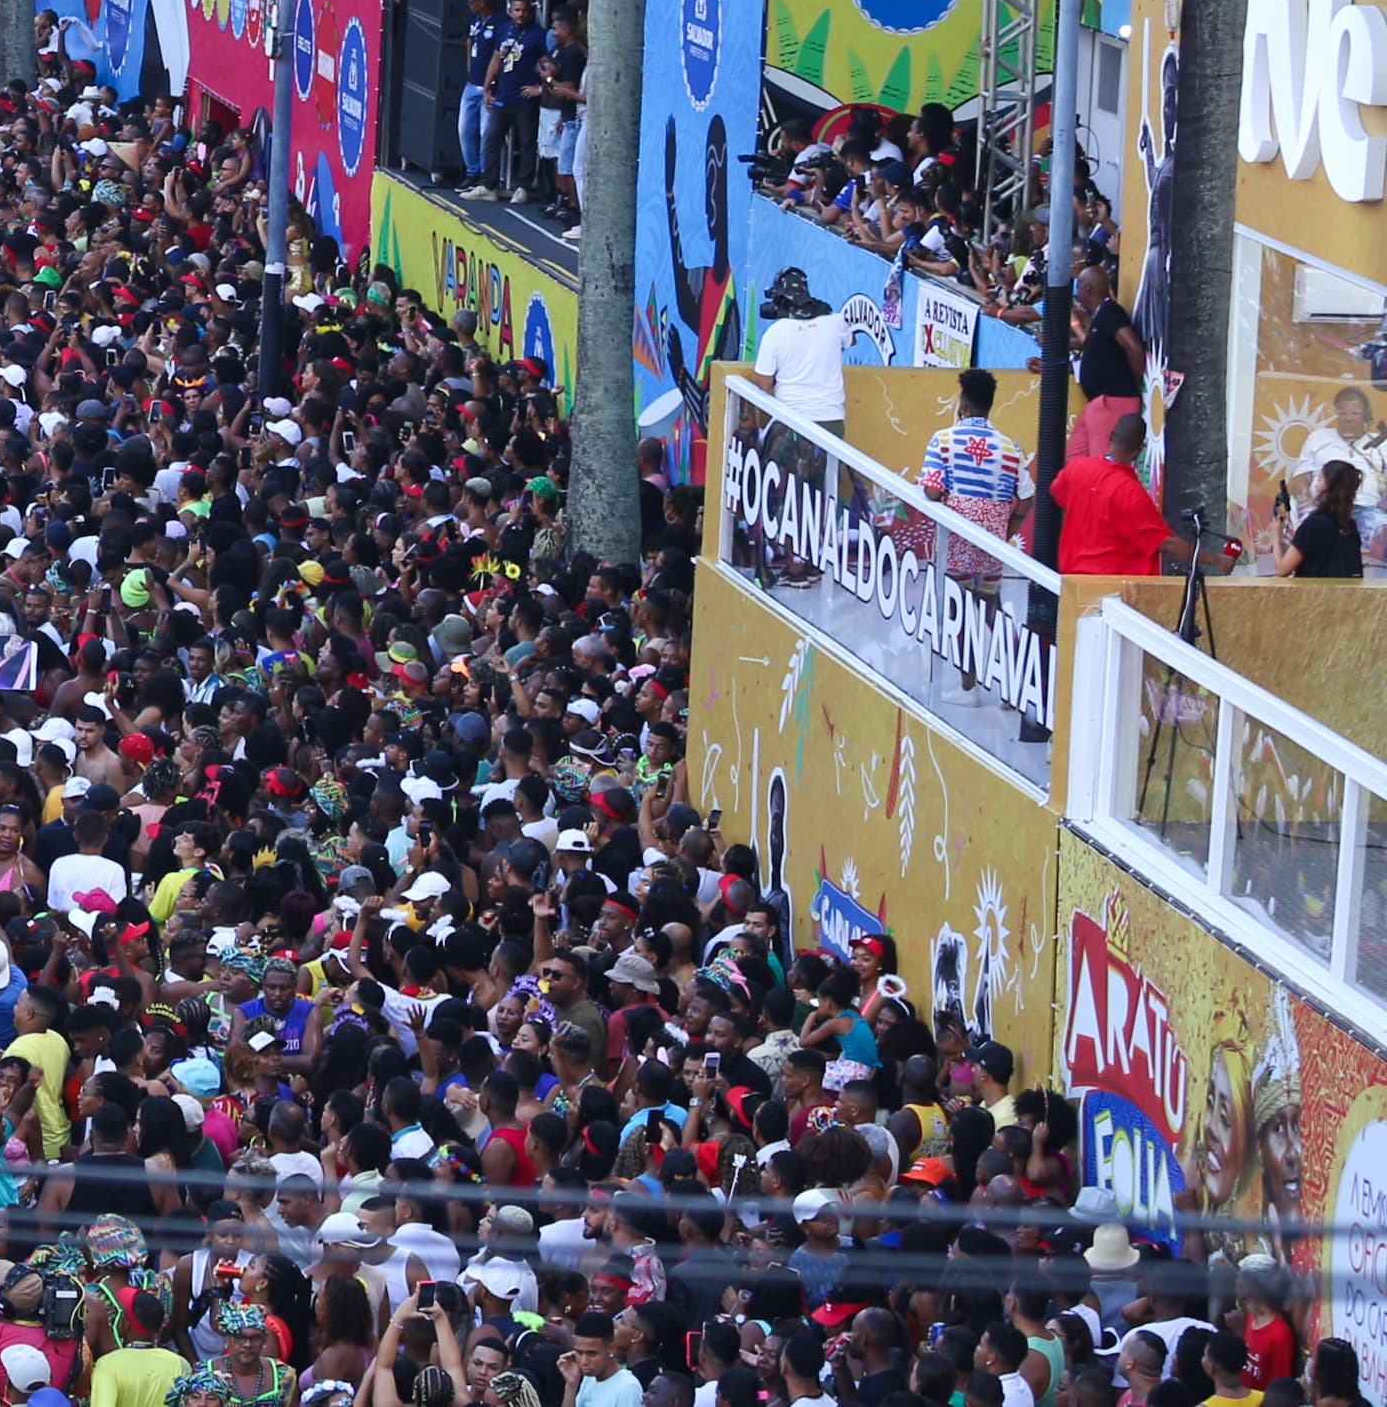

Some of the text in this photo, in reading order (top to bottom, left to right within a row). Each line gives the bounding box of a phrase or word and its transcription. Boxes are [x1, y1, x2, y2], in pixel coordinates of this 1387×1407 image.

[686, 22, 714, 51] SALVADOR
[431, 230, 515, 361] VARANDA
[924, 297, 932, 318] A
[933, 301, 969, 336] REVISTA
[1067, 945, 1186, 1136] ARATU
[1093, 1110, 1177, 1241] FOLIA
[1345, 1280, 1365, 1327] DO
